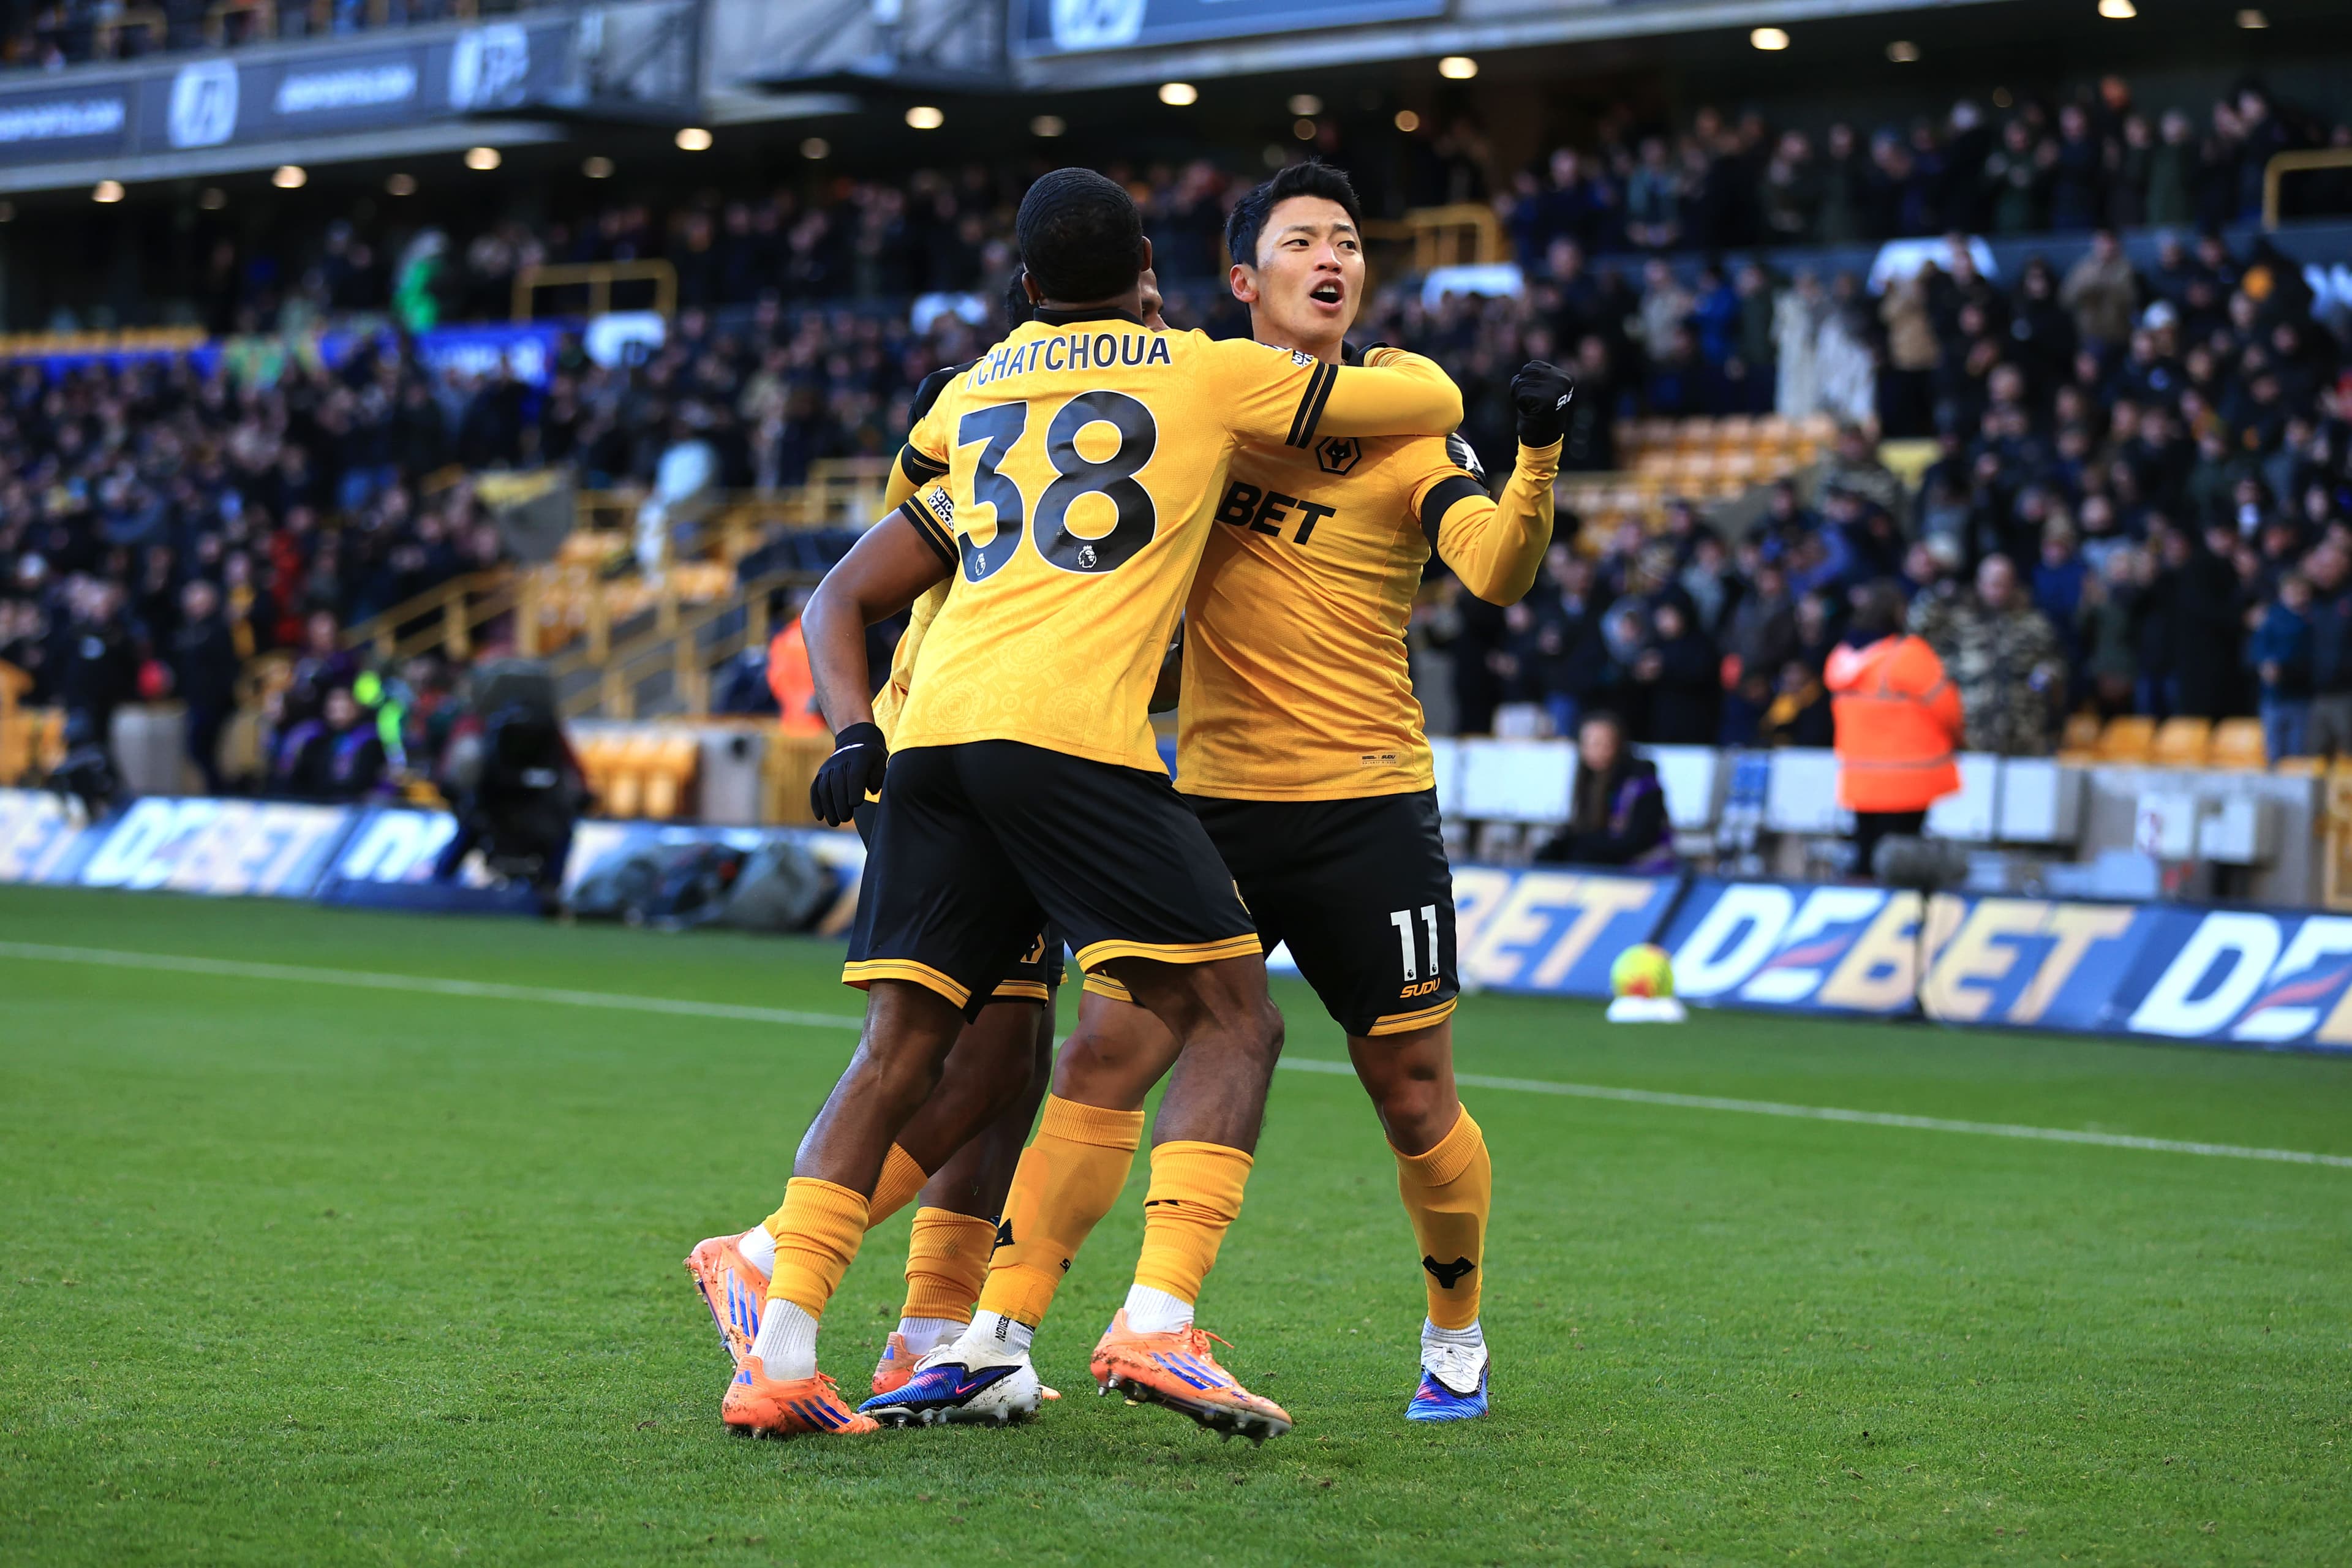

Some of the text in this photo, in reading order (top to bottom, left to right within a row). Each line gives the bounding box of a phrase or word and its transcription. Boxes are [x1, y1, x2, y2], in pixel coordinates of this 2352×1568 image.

[934, 486, 946, 502] No
[935, 505, 954, 530] racis
[958, 390, 1158, 584] 38
[1215, 481, 1336, 545] BET
[1390, 904, 1439, 981] 11
[1400, 978, 1441, 998] SUDU
[2127, 910, 2352, 1045] DE
